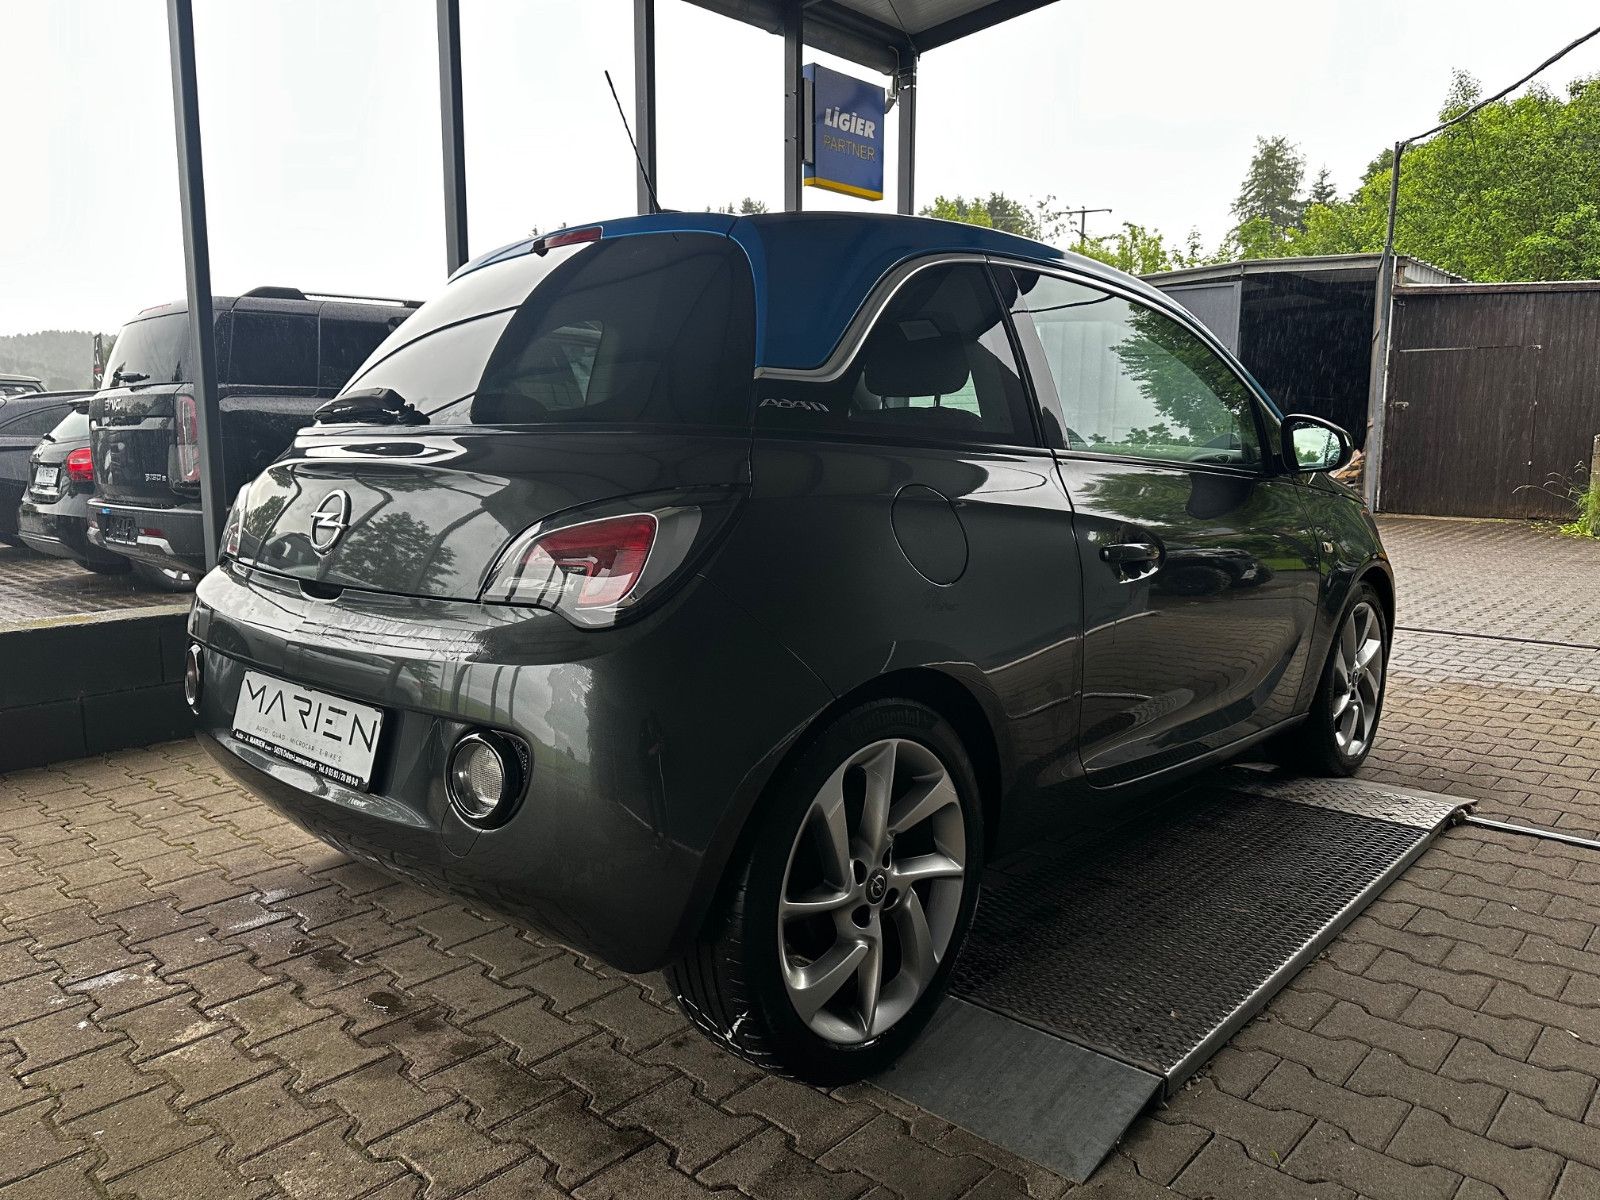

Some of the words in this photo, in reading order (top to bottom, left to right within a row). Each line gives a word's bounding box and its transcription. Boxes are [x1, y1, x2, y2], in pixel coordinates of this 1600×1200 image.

[823, 134, 876, 161] PARTNER
[246, 679, 378, 753] MARIEN
[256, 724, 269, 734] AUTO
[249, 736, 266, 749] MARIEN
